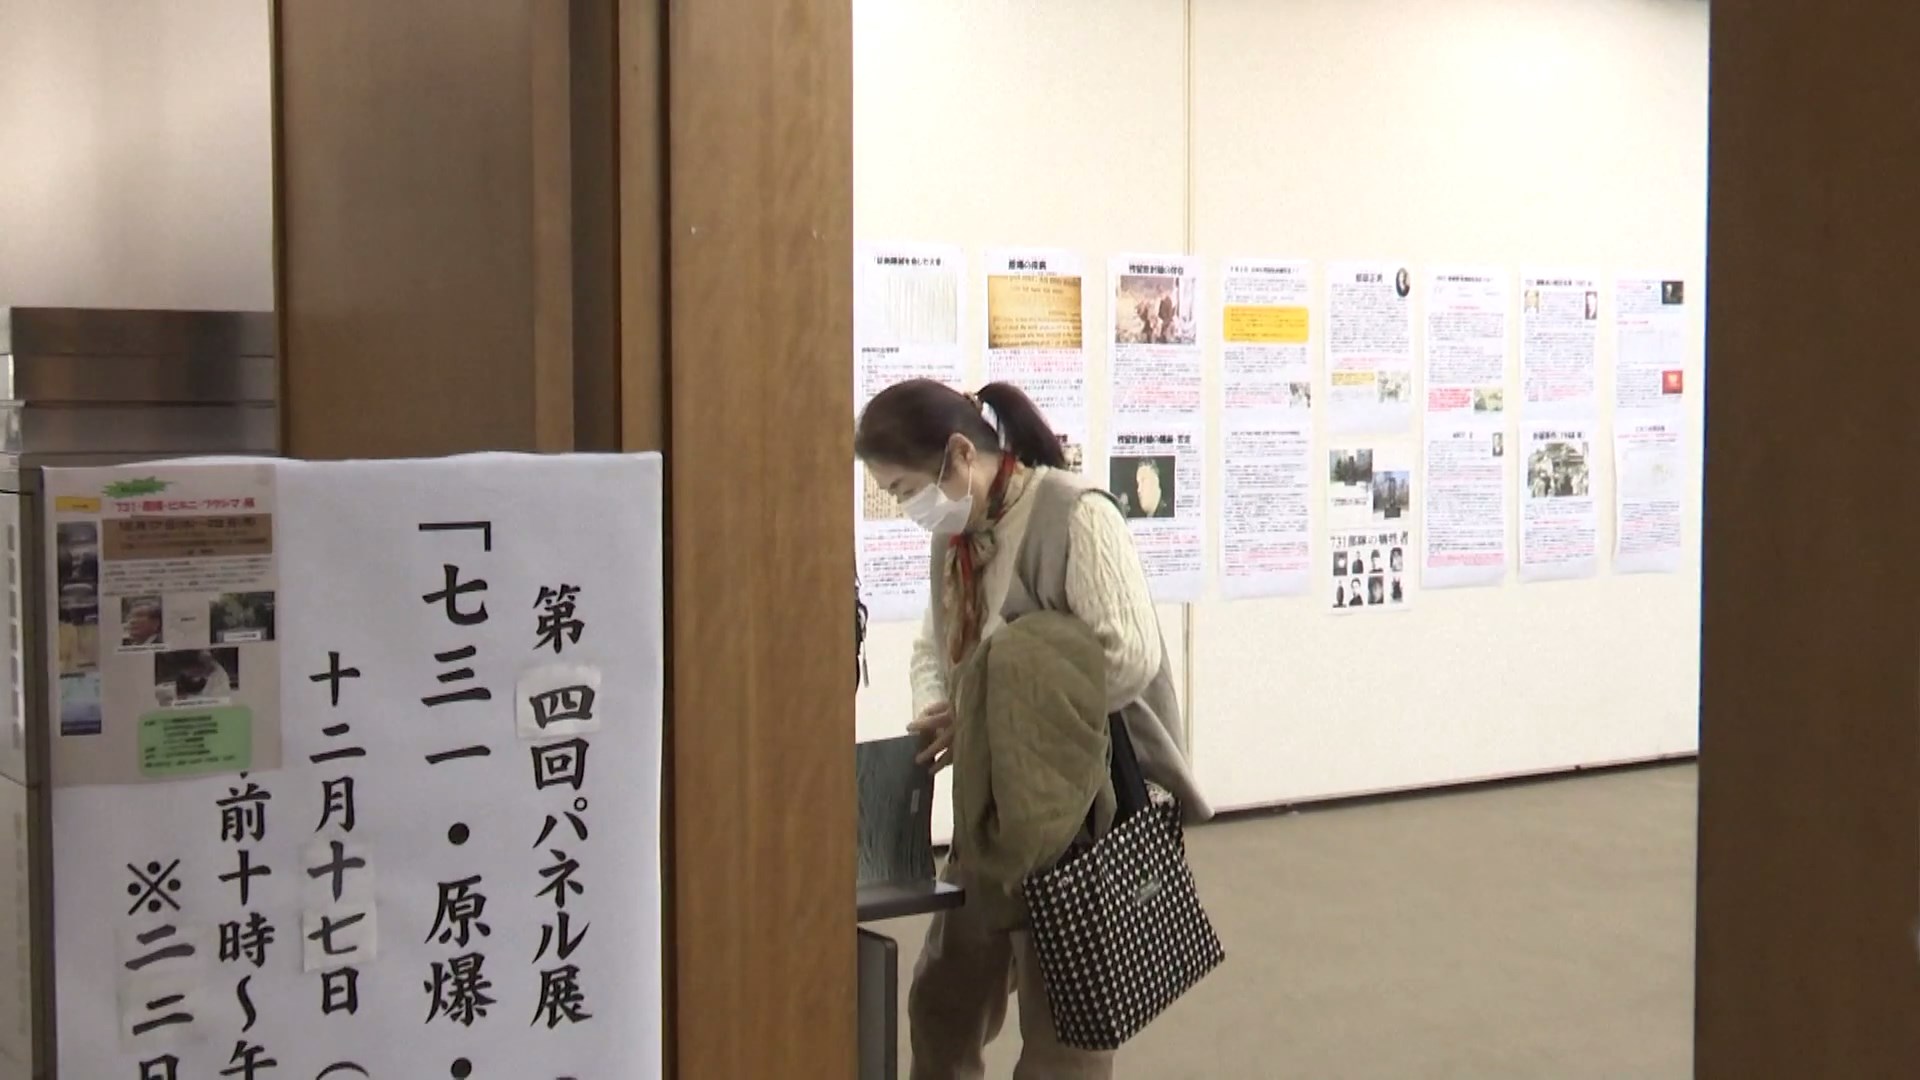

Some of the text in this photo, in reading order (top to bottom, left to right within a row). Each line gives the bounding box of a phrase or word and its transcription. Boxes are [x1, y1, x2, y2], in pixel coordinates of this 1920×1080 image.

[529, 583, 596, 1030] 第四回パネル展
